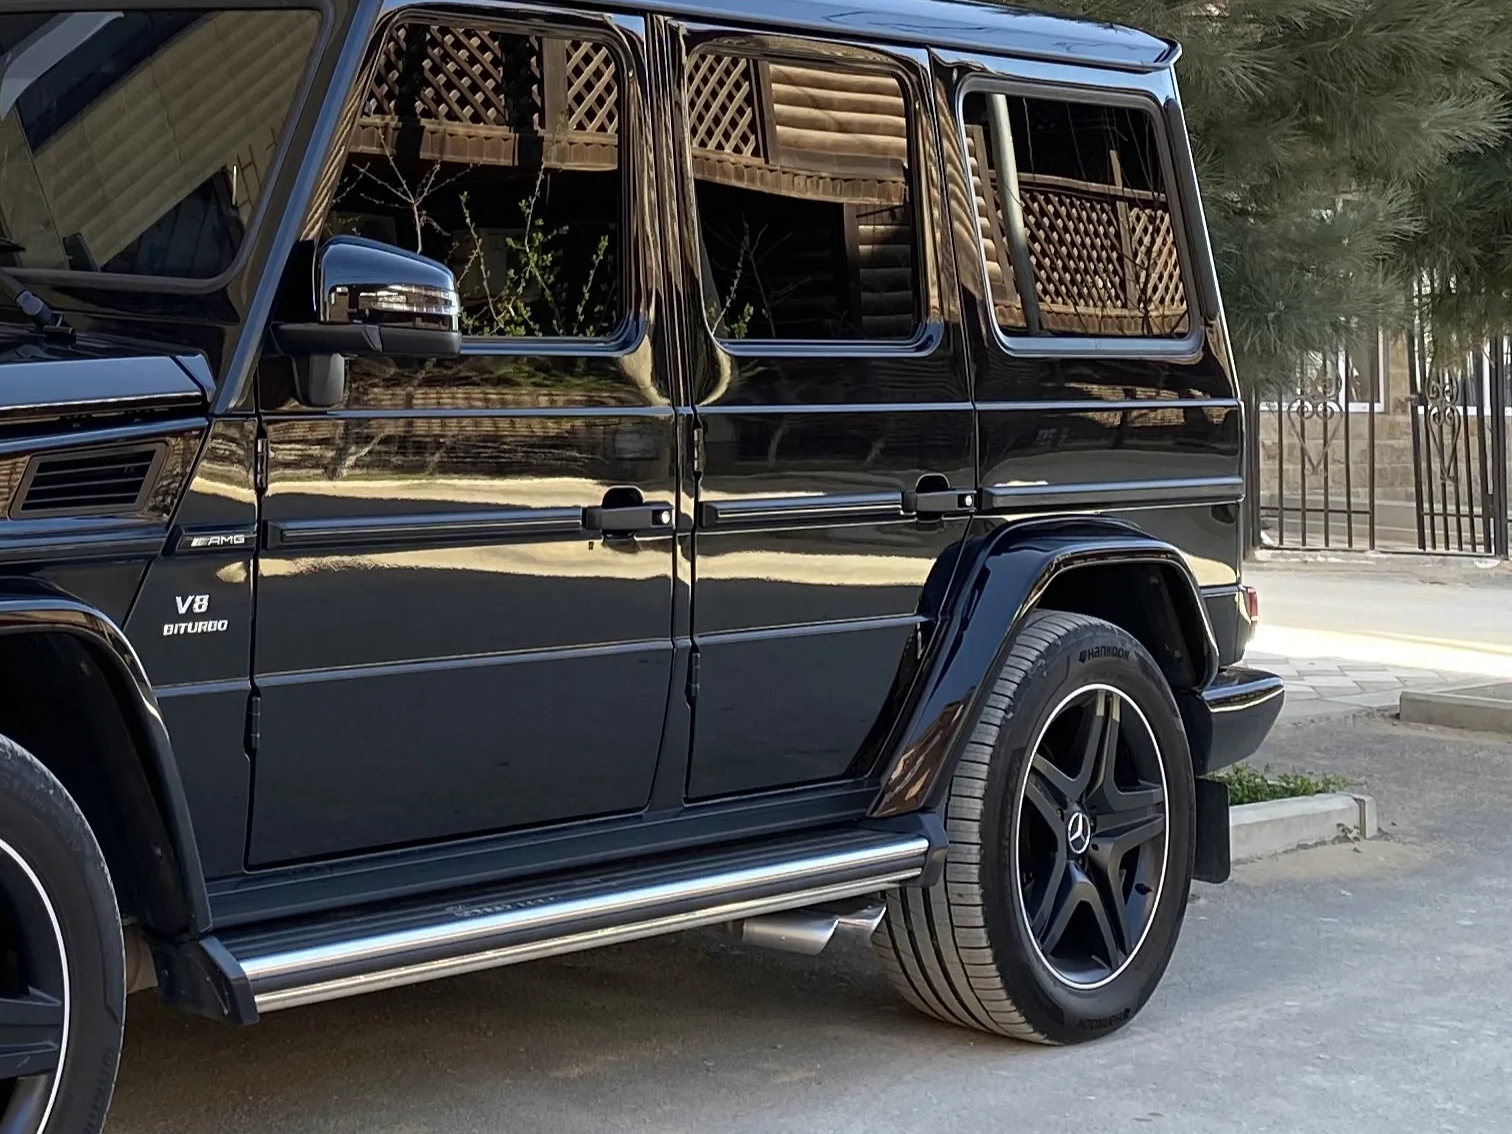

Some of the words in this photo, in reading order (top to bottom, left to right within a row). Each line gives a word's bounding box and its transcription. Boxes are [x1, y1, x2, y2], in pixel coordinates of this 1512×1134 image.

[207, 534, 245, 546] AMG
[175, 594, 210, 615] V8
[163, 619, 229, 636] BITURBO
